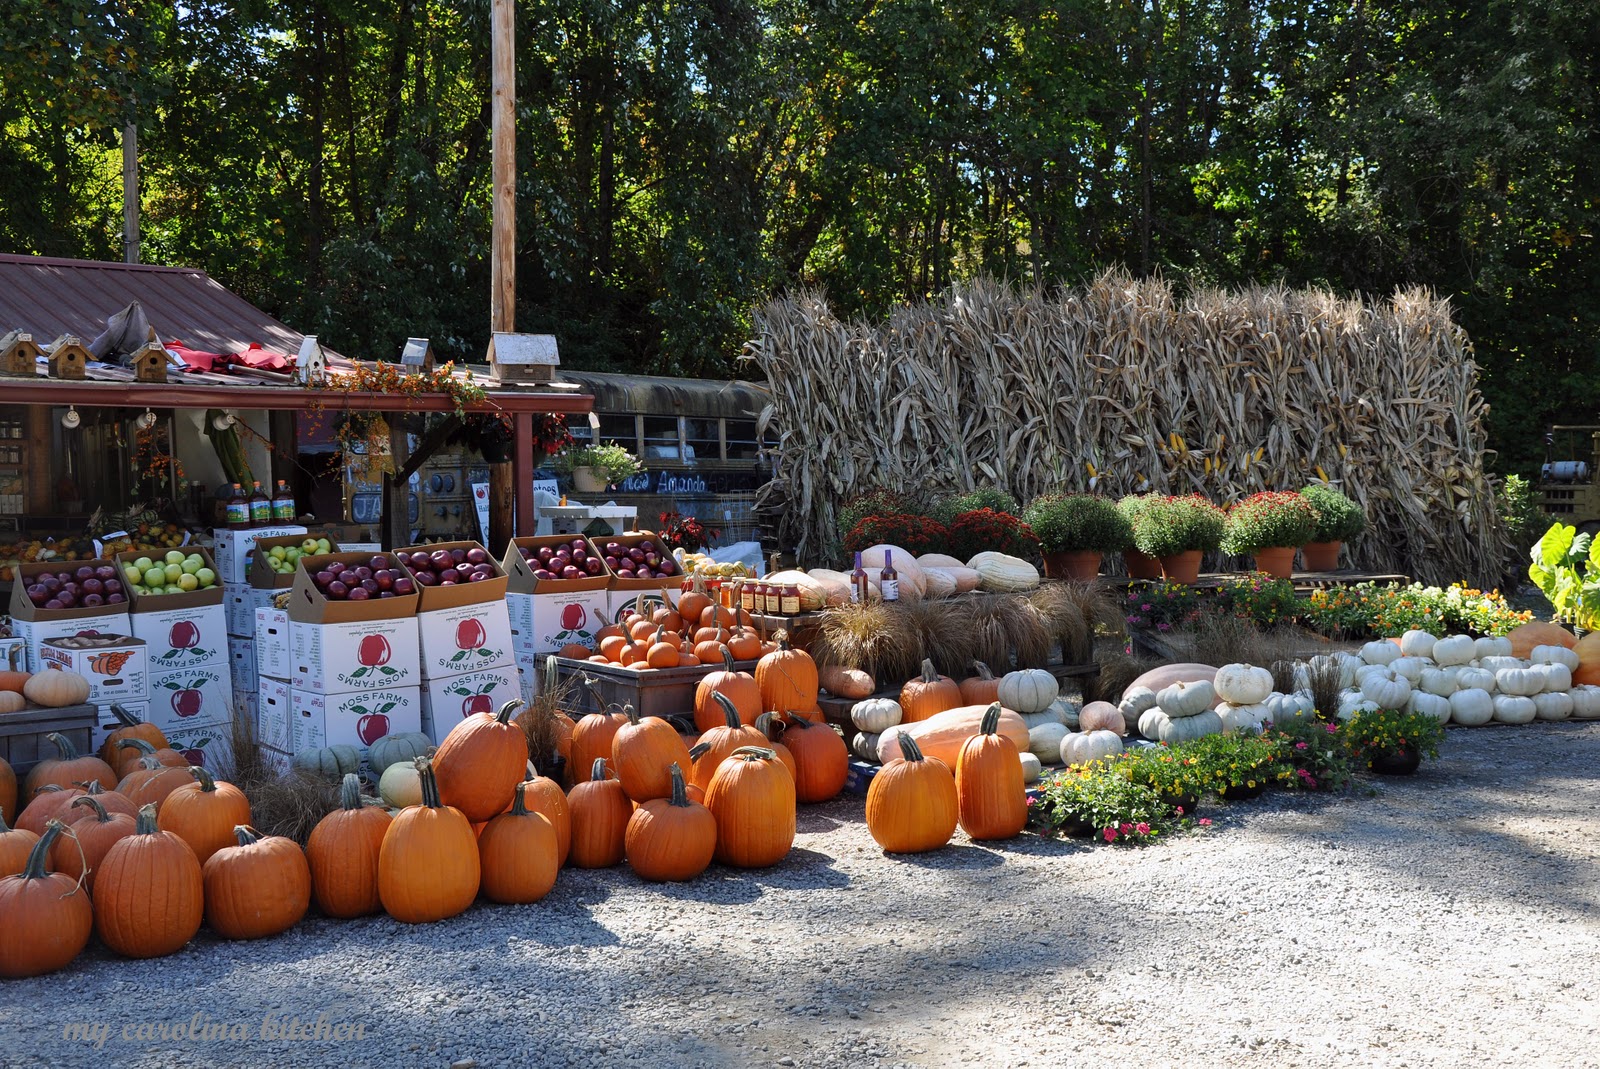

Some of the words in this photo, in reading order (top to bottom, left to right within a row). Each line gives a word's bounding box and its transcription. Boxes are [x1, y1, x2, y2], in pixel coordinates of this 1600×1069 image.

[657, 470, 706, 493] Amanda
[149, 655, 186, 668] FARMS
[188, 648, 217, 664] MOSS
[438, 658, 474, 671] FARMS
[476, 648, 504, 669] MOSS
[152, 671, 182, 690] MOSS
[184, 670, 220, 682] FARMS
[337, 673, 376, 688] FARMS
[379, 667, 409, 687] MOSS
[443, 675, 472, 696] MOSS
[473, 673, 509, 686] FARMS
[338, 692, 370, 713] MOSS
[372, 692, 409, 707] FARMS
[166, 731, 186, 743] OSS
[187, 729, 224, 741] FARMS
